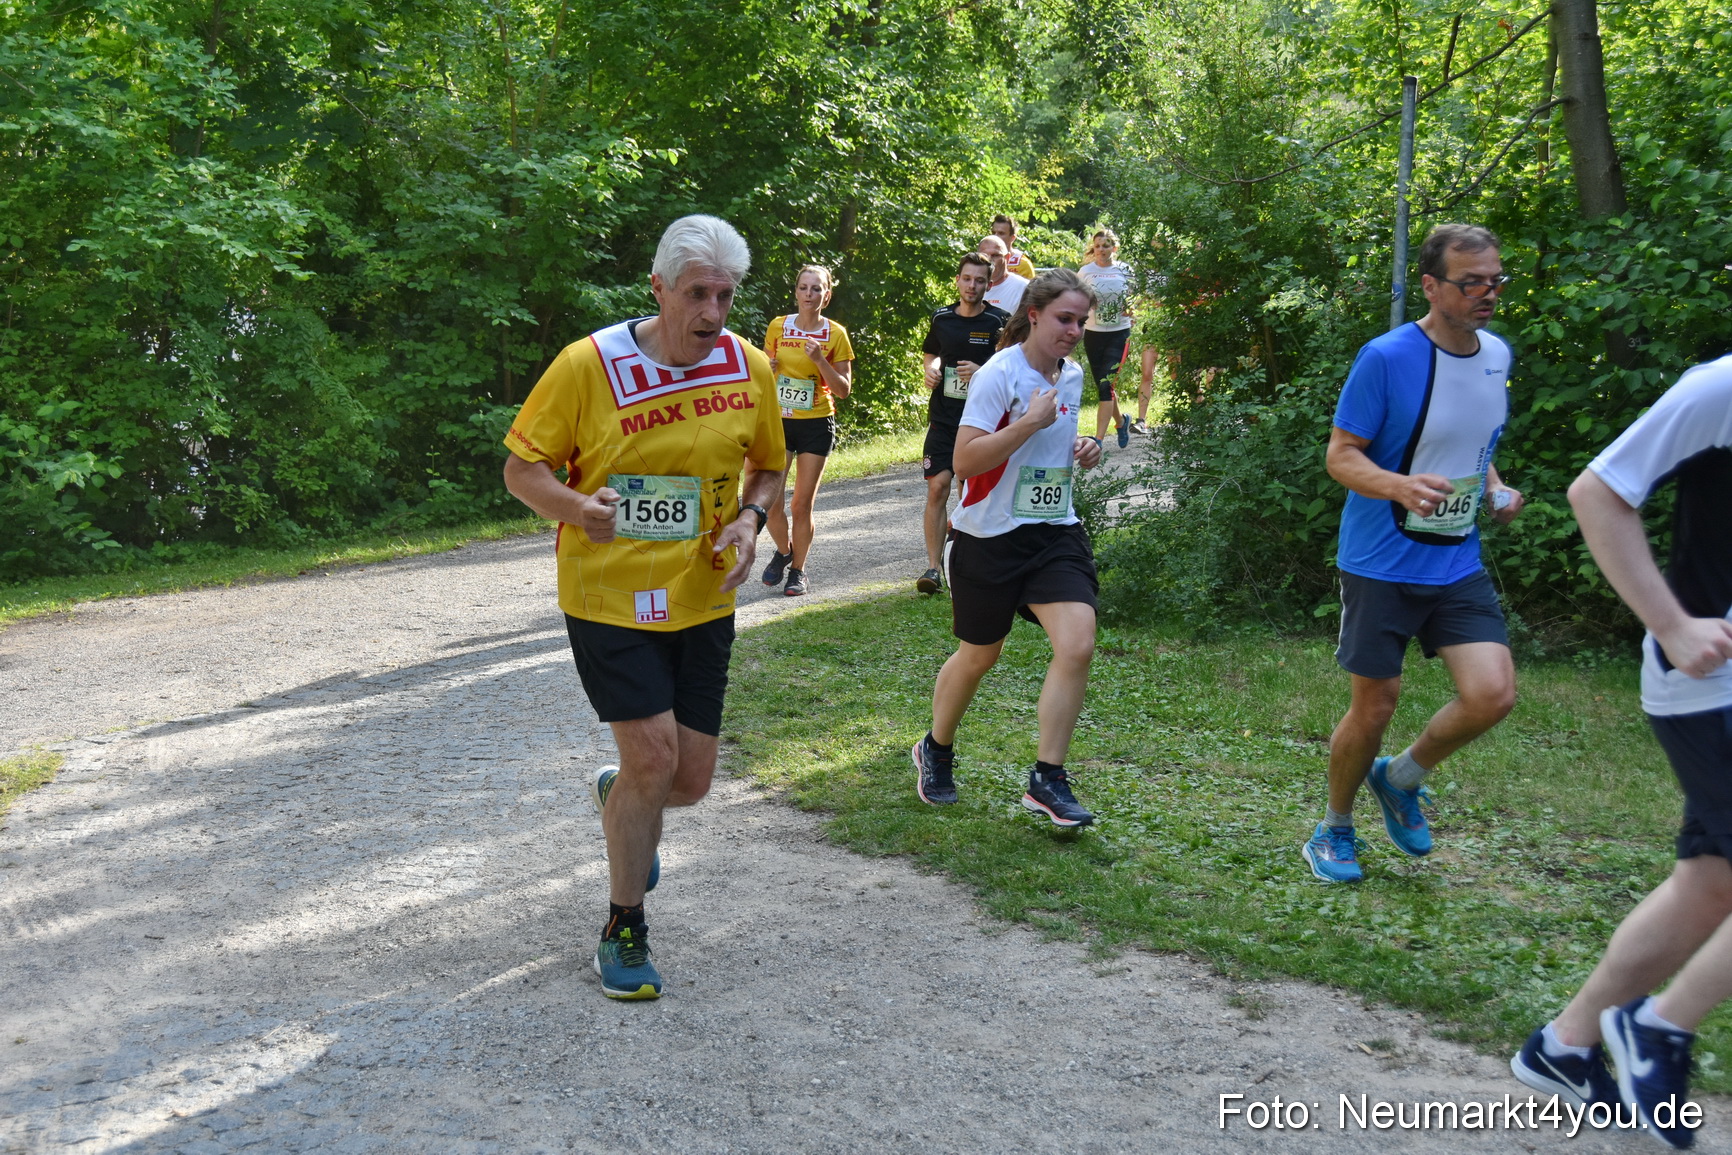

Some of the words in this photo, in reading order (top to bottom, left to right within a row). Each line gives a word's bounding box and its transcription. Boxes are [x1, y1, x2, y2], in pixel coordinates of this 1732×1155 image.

[779, 386, 808, 402] 1573
[952, 378, 970, 391] 12
[620, 403, 687, 437] MAX
[693, 390, 755, 417] BÖGL
[1476, 446, 1486, 472] WASTE
[1030, 486, 1062, 505] 369
[1434, 494, 1472, 518] 046
[619, 498, 687, 523] 1568
[632, 522, 651, 530] Fruth
[653, 523, 674, 531] Anton
